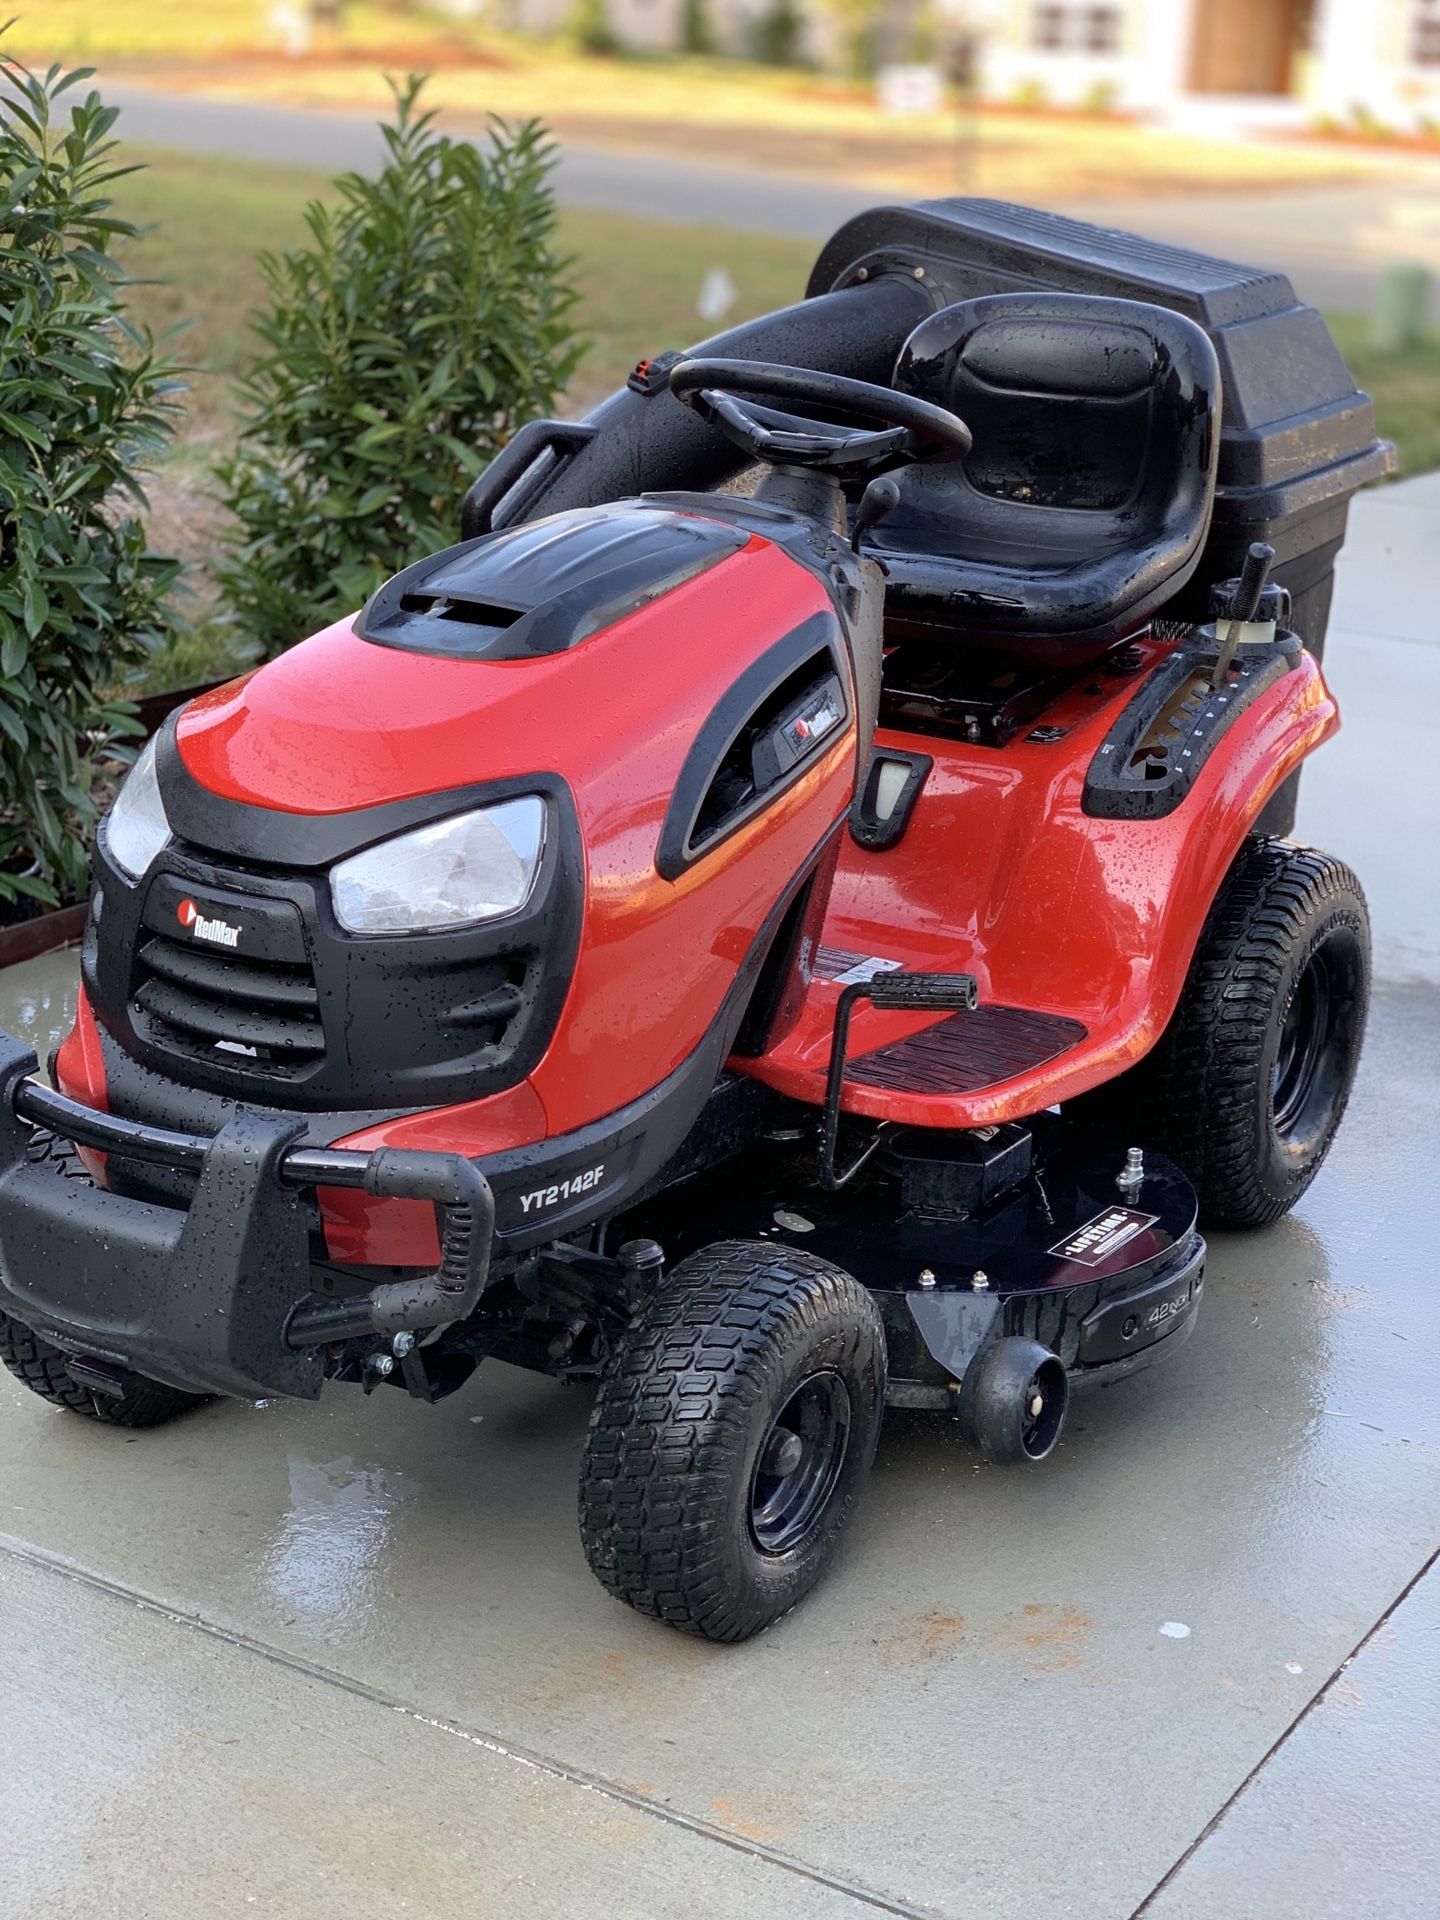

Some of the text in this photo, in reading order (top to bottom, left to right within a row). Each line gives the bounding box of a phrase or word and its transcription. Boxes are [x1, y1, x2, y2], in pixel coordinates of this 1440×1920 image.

[193, 914, 241, 948] RedMax
[520, 1164, 605, 1213] YT2142F
[1064, 1213, 1129, 1254] LIFETIME
[1148, 1302, 1169, 1322] 42
